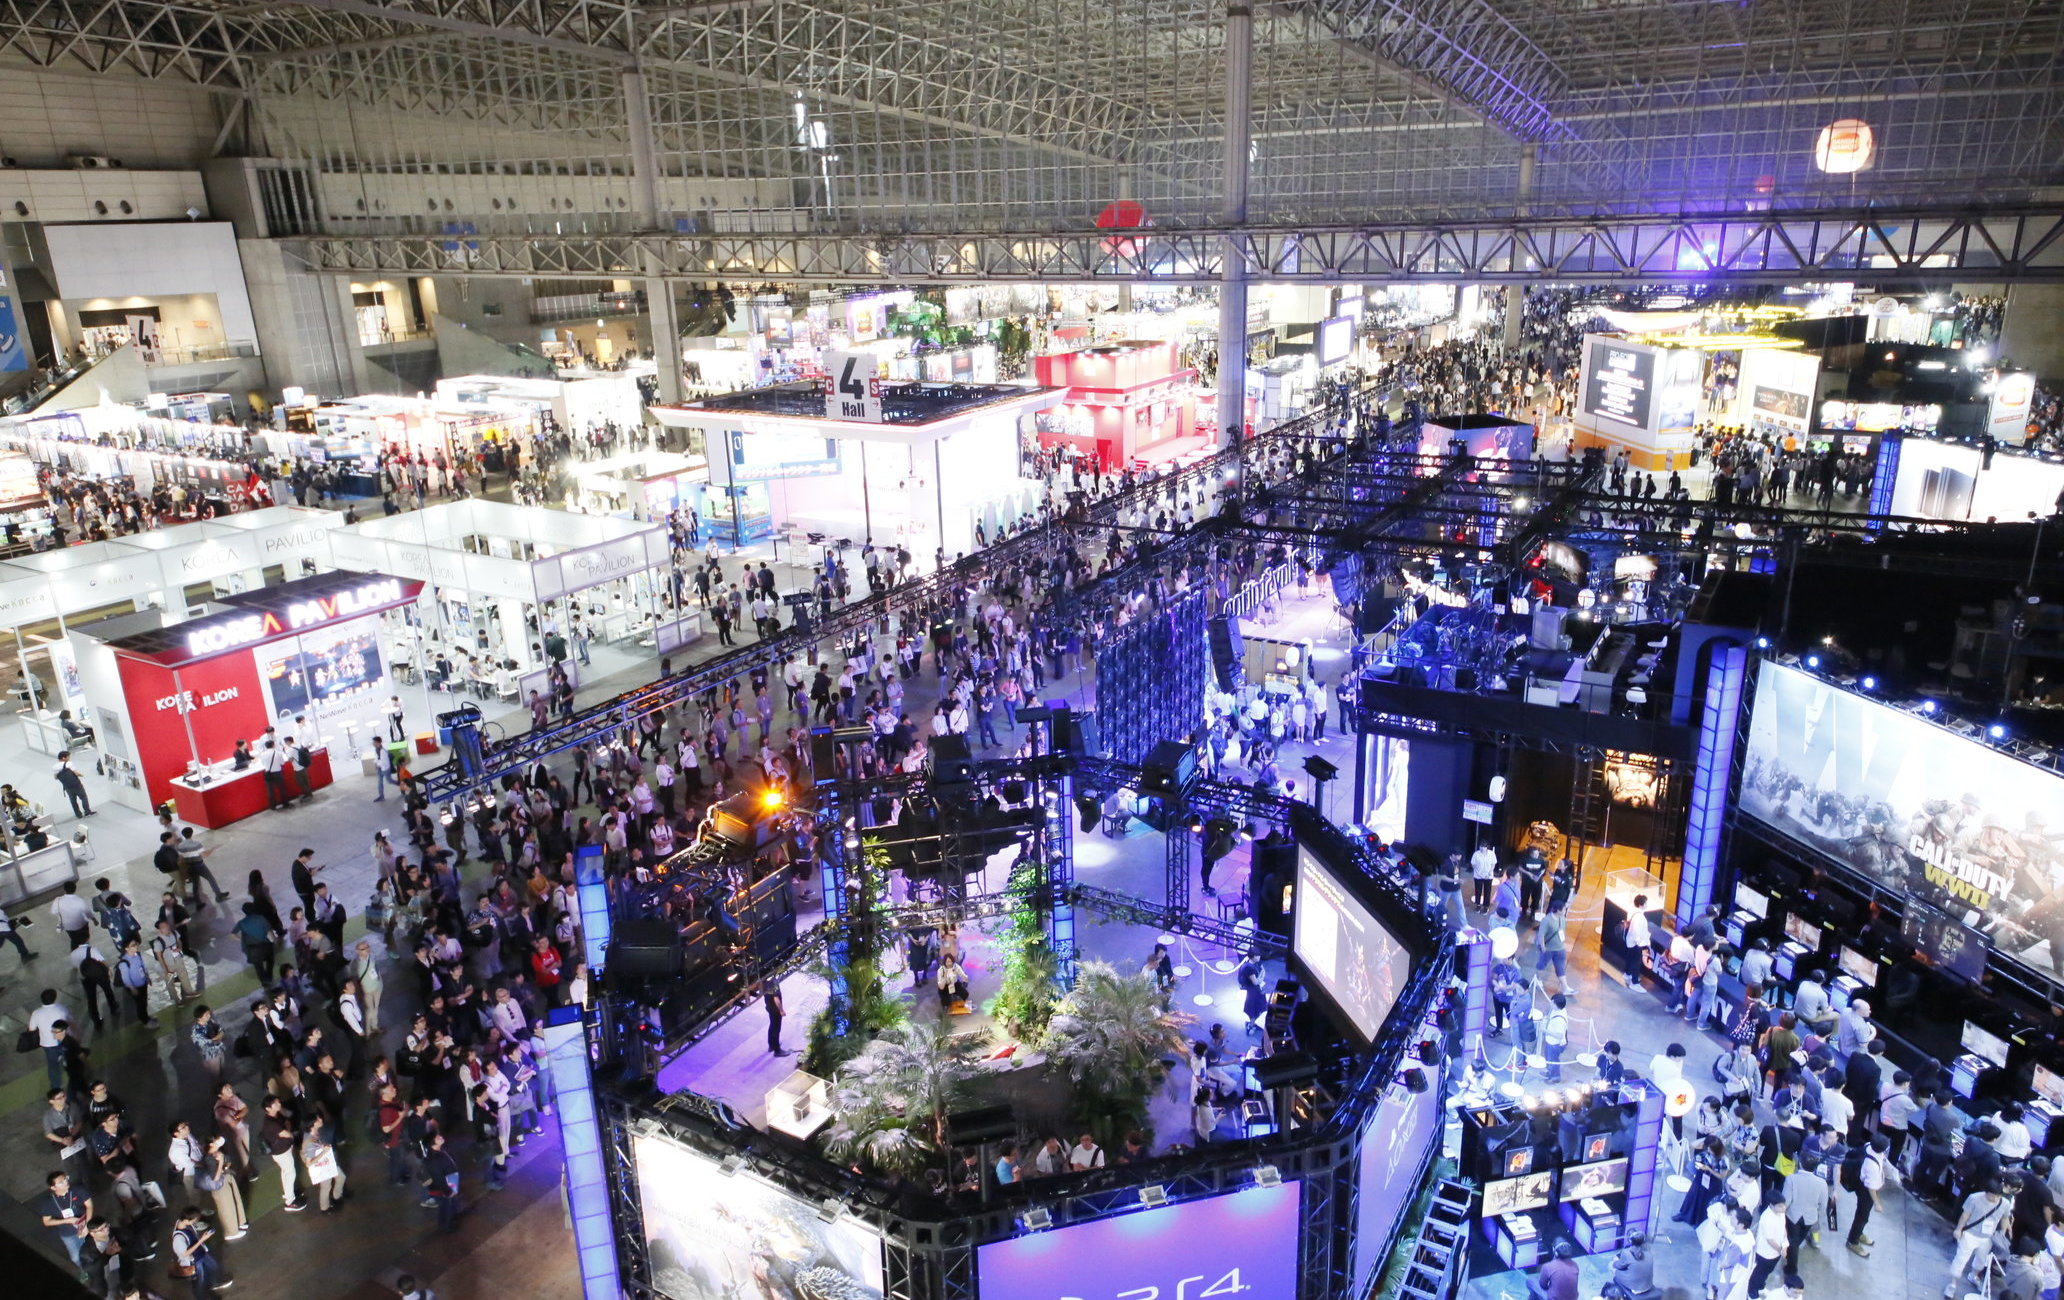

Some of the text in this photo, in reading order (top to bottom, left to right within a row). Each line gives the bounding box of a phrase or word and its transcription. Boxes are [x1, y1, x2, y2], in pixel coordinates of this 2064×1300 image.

[138, 319, 152, 350] 4
[825, 378, 834, 392] C
[839, 356, 865, 400] 4
[870, 381, 879, 395] S
[841, 401, 866, 418] Hall
[588, 555, 635, 577] PAVILION
[187, 578, 402, 657] KOREA PAVILION
[1910, 834, 1954, 873] CALL
[1956, 858, 2015, 902] DUTY
[1924, 862, 1990, 910] WWII
